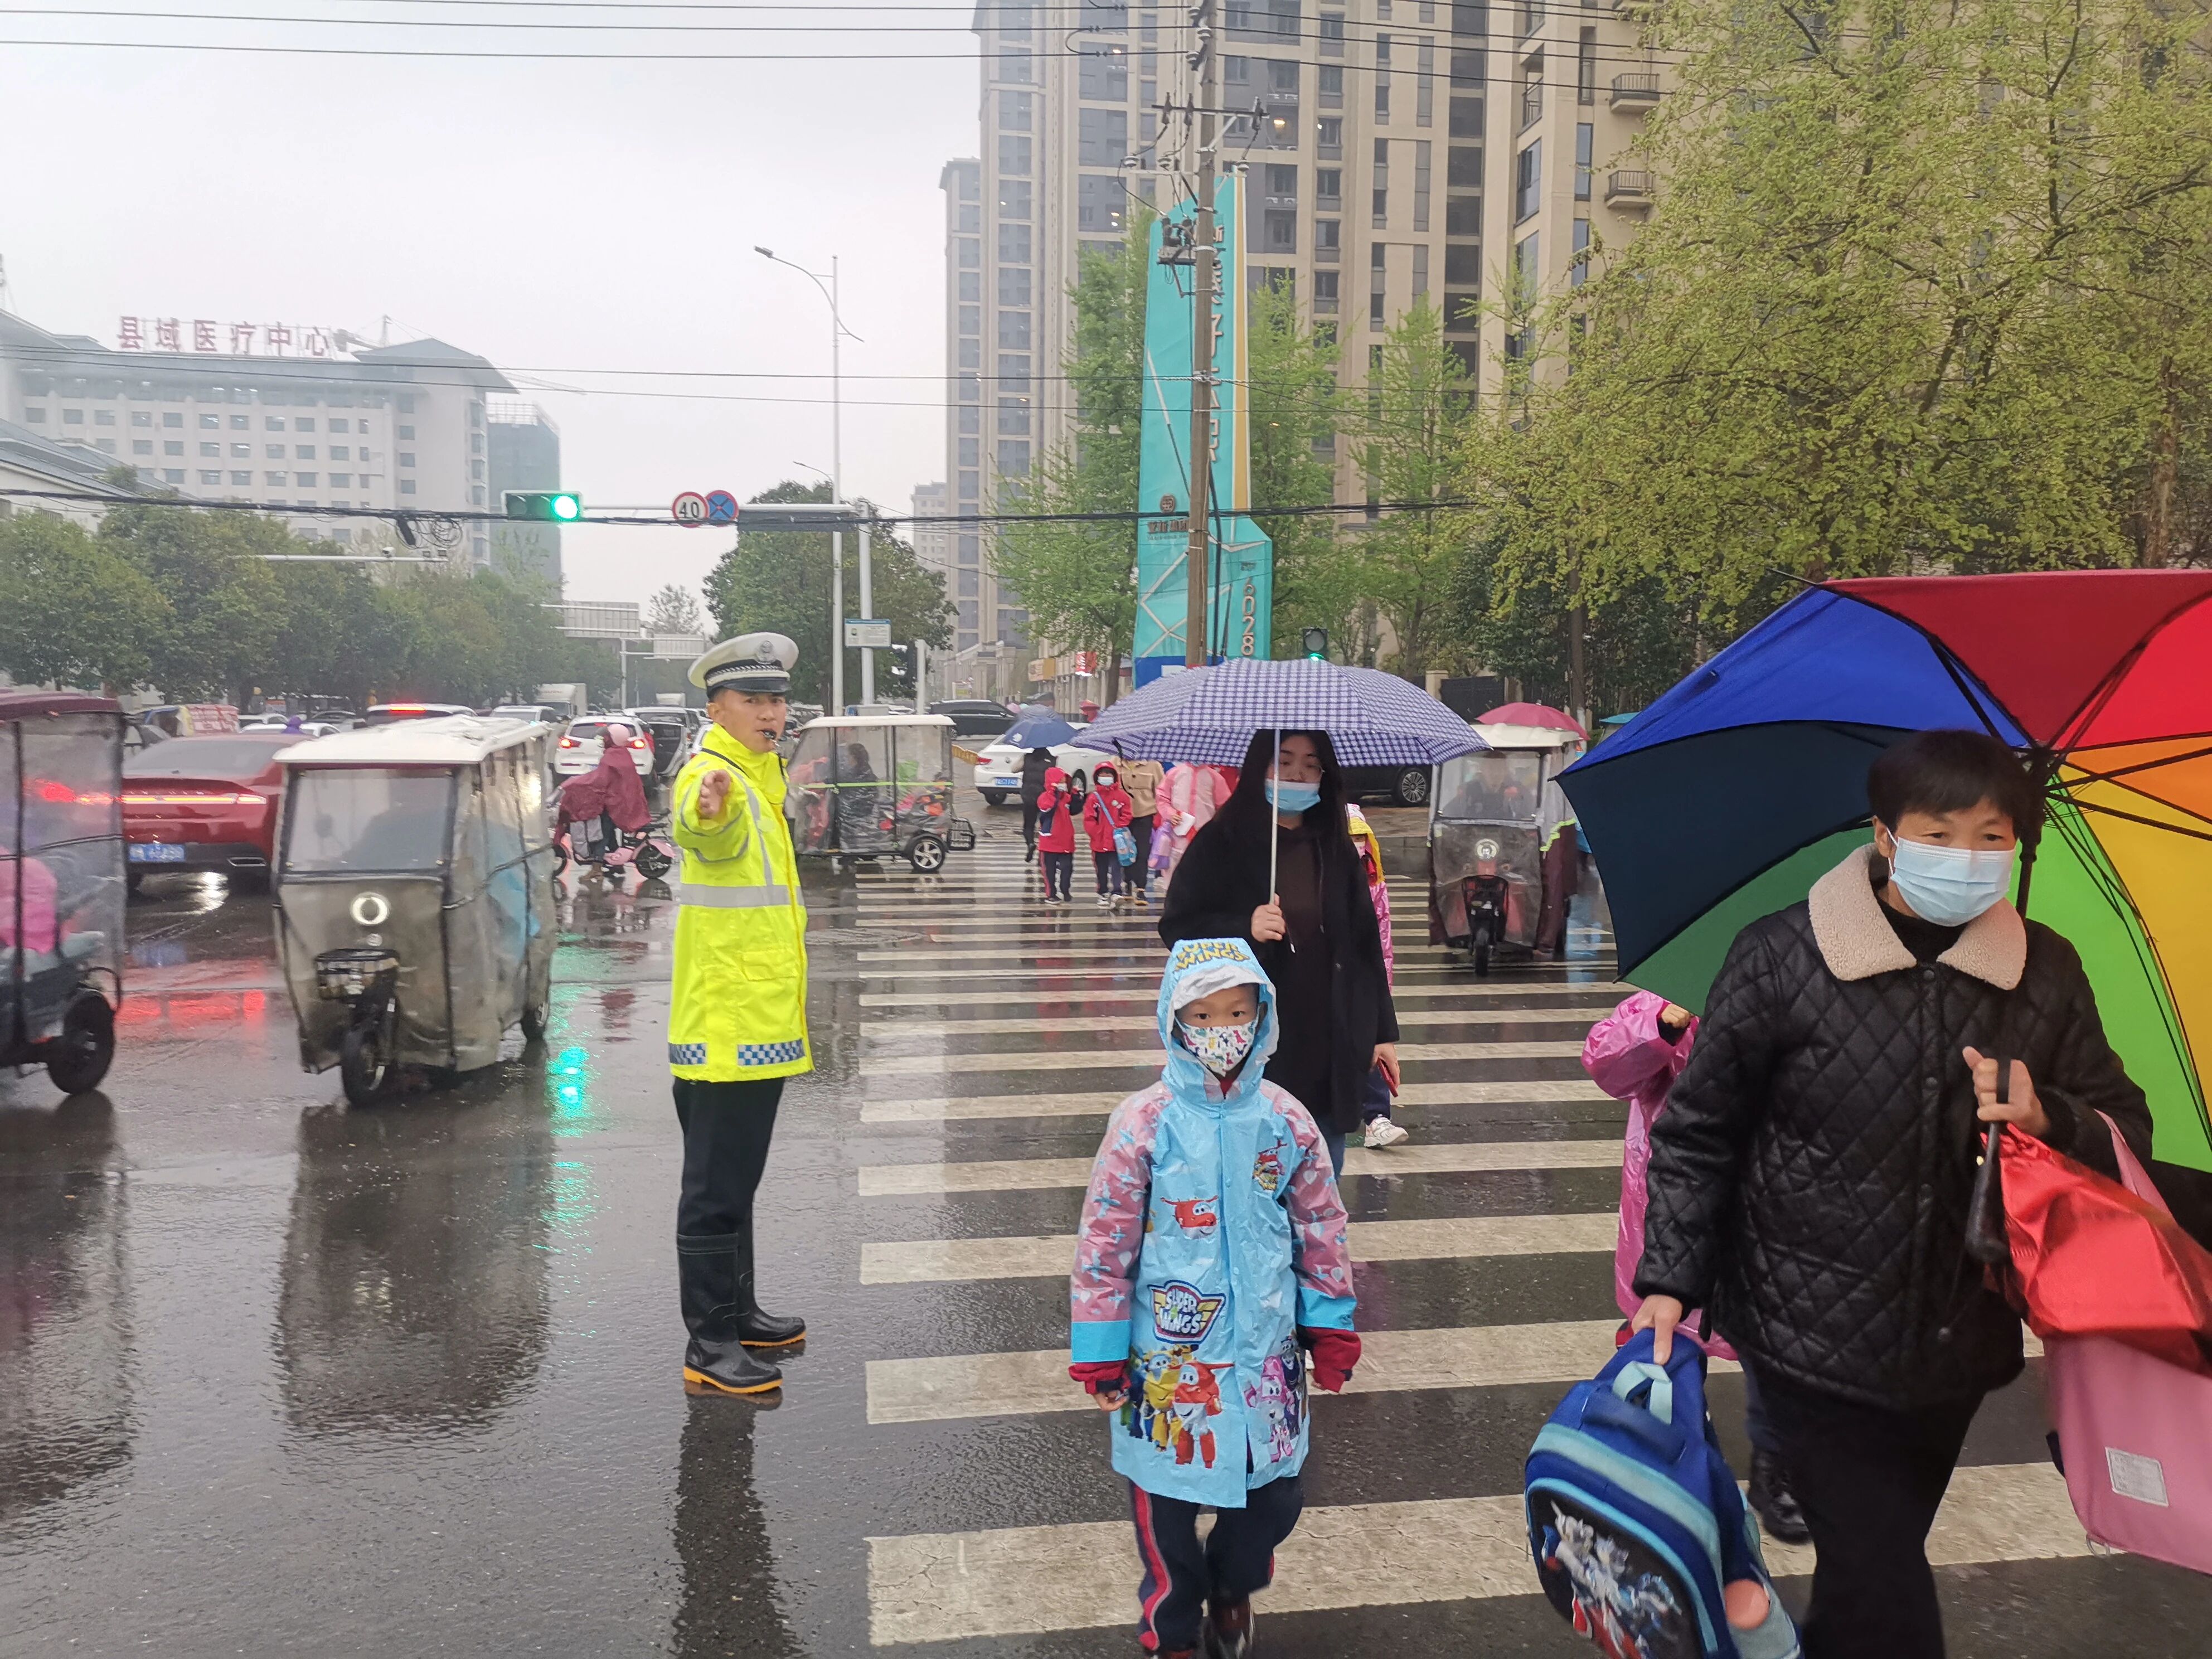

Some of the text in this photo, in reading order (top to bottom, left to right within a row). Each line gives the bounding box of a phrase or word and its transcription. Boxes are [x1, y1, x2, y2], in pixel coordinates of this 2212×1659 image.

[117, 316, 330, 357] 县域医疗中心
[678, 501, 699, 518] 40
[1241, 576, 1255, 656] 6028
[1166, 1288, 1197, 1314] SUPER
[1159, 1307, 1202, 1334] WINGS
